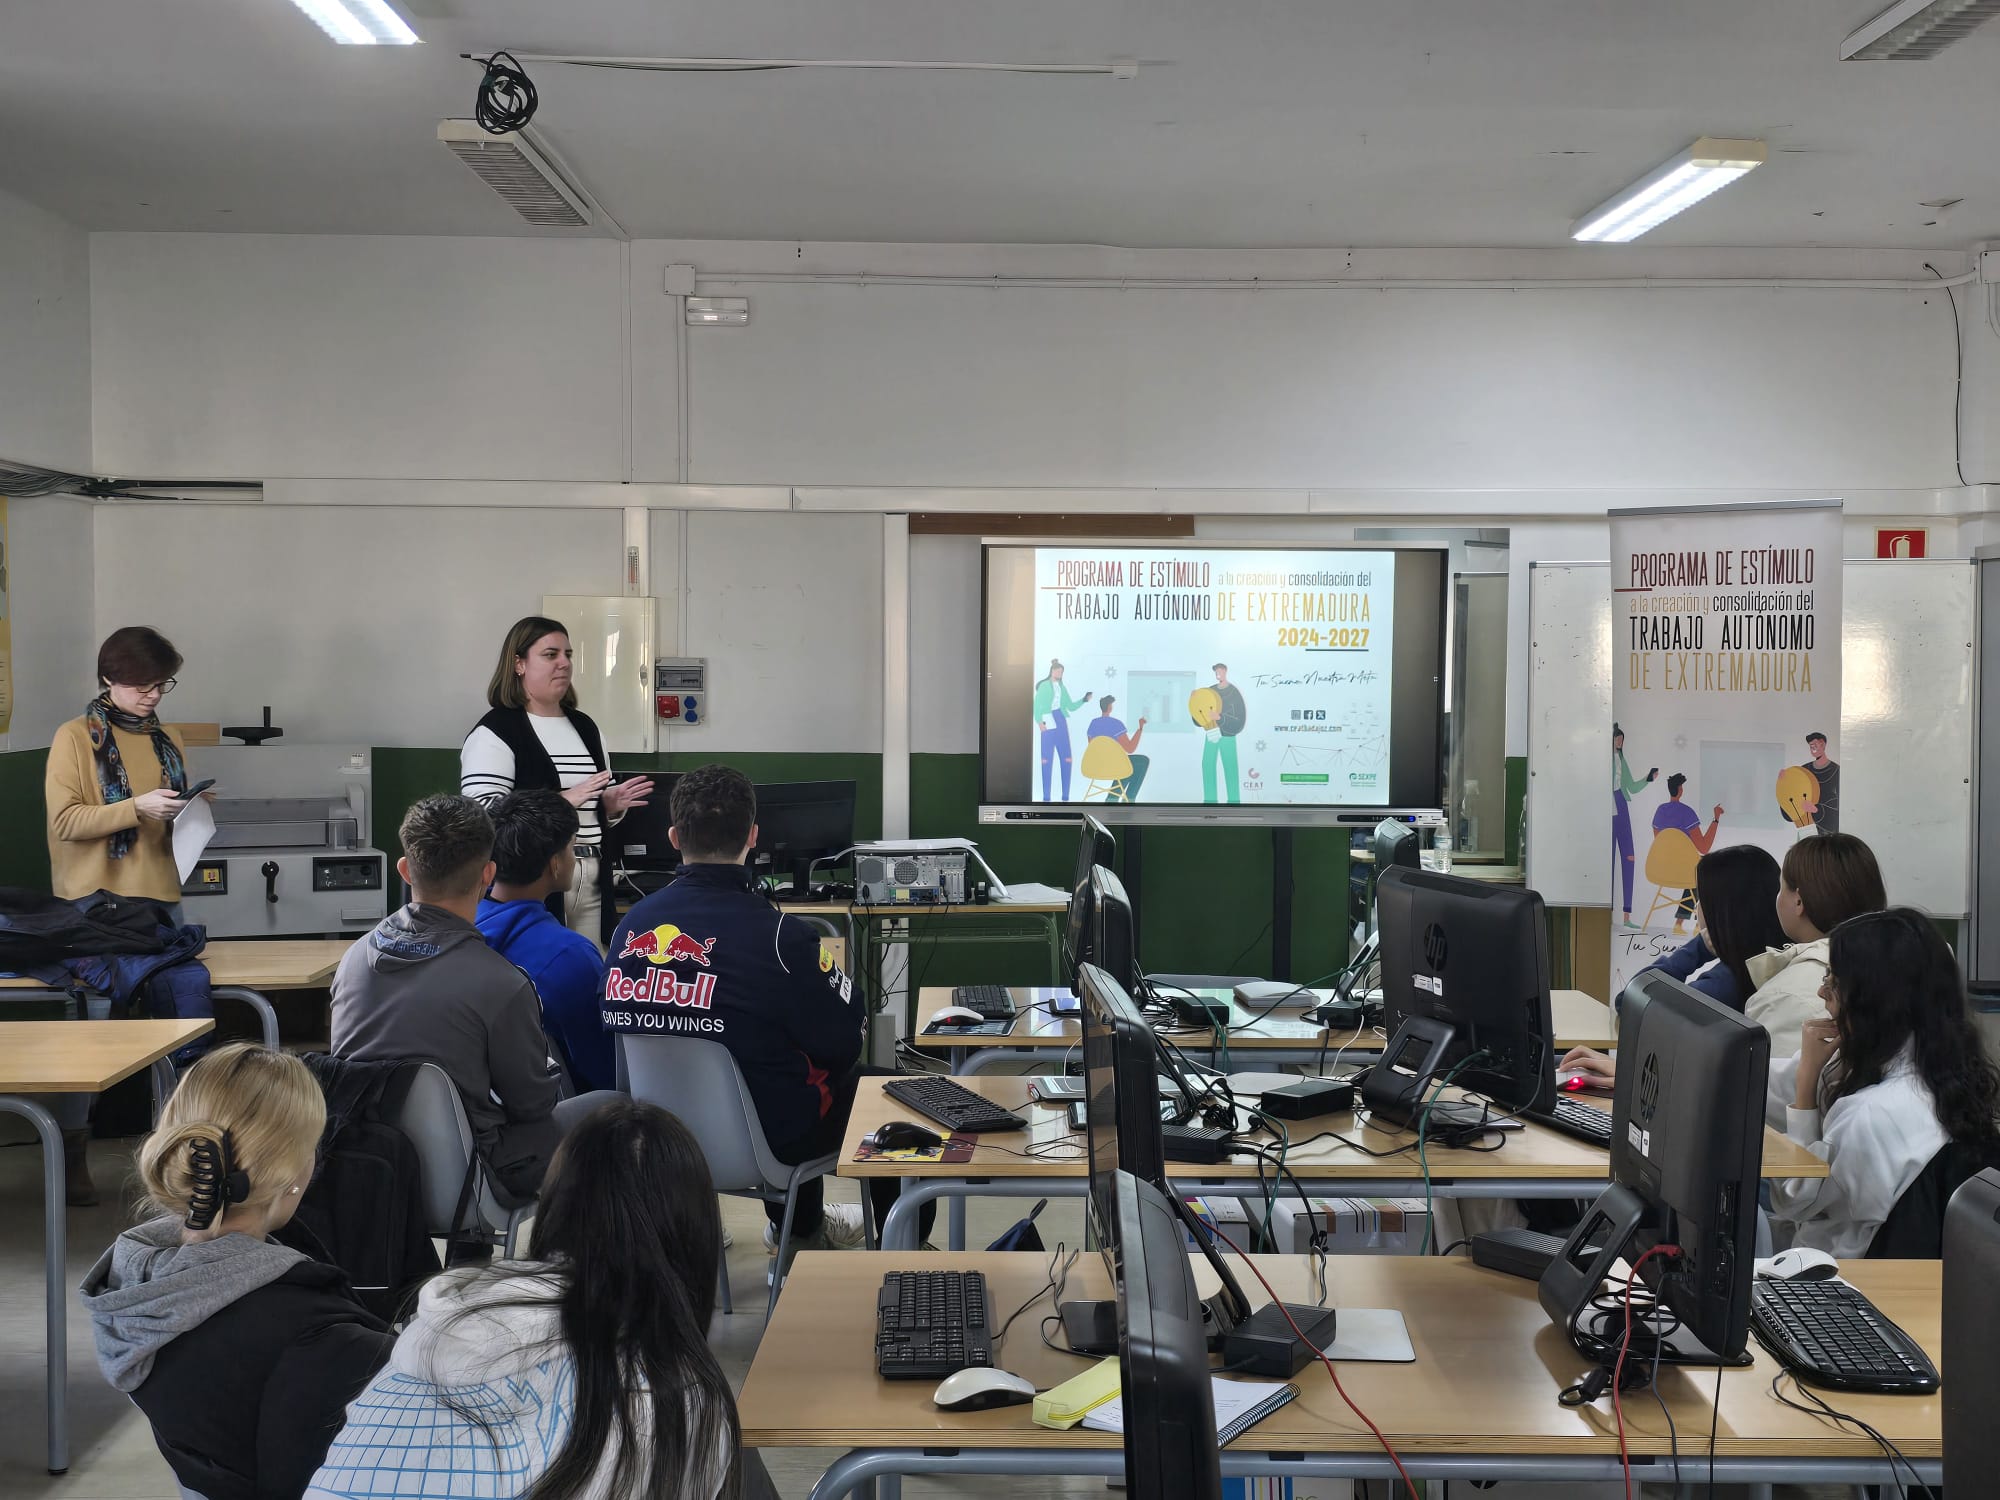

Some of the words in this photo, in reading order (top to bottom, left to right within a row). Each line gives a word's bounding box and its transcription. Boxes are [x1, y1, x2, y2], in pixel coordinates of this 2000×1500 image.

[1058, 560, 1124, 587] PROGRAMA
[1129, 561, 1144, 588] DE
[1150, 558, 1210, 588] ESTÍMULO
[1218, 575, 1224, 586] a
[1226, 572, 1234, 586] la
[1236, 572, 1277, 586] creación
[1280, 574, 1286, 588] y
[1289, 571, 1354, 587] consolidación
[1357, 571, 1372, 587] del
[1632, 552, 1708, 587] PROGRAMA
[1716, 551, 1733, 585] DE
[1741, 544, 1815, 585] ESTÍMULO
[1057, 592, 1119, 620] TRABAJO
[1134, 590, 1211, 621] AUTÓNOMO
[1218, 592, 1236, 622] DE
[1247, 592, 1370, 622] EXTREMADURA
[1630, 600, 1637, 613] a
[1639, 595, 1648, 613] la
[1651, 593, 1700, 613] creación
[1703, 595, 1710, 615] y
[1713, 591, 1793, 612] consolidación
[1796, 590, 1814, 612] del
[1278, 628, 1370, 647] 2024-2027
[1630, 616, 1703, 650] TRABAJO
[1721, 609, 1815, 650] AUTÓNOMO
[1630, 652, 1652, 691] DE
[1664, 652, 1812, 692] EXTREMADURA
[1618, 933, 1648, 956] Tu
[606, 967, 656, 1002] Red
[652, 969, 718, 1010] Bull
[602, 1010, 632, 1026] GIVES
[634, 1012, 665, 1028] YOU
[668, 1015, 725, 1033] WINGS
